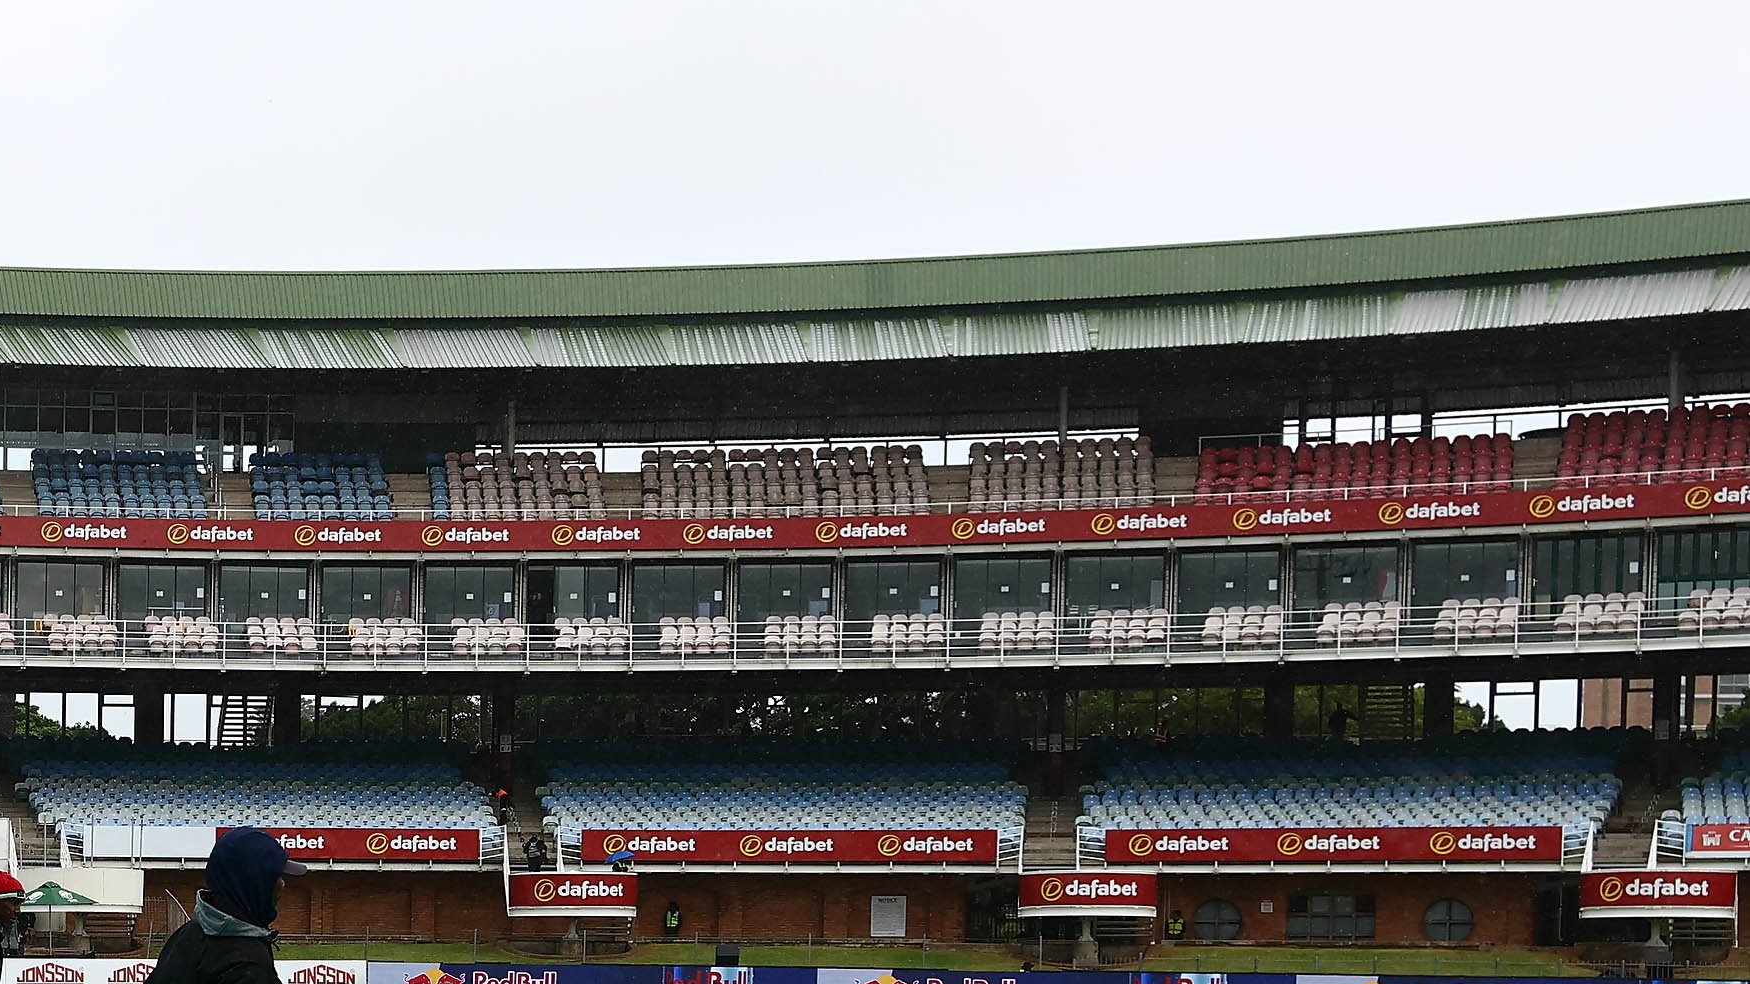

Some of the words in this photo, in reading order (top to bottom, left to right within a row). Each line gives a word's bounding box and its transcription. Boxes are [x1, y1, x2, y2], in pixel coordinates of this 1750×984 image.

[1713, 485, 1750, 504] daf
[1403, 503, 1480, 521] dafabet
[1557, 494, 1634, 513] dafabet
[1117, 514, 1187, 531] dafabet
[1259, 508, 1331, 526] dafabet
[64, 524, 126, 540] dafabet
[190, 526, 253, 542] dafabet
[445, 527, 509, 544] dafabet
[575, 526, 640, 543] dafabet
[707, 525, 773, 541] dafabet
[840, 523, 907, 539] dafabet
[977, 518, 1045, 536] dafabet
[318, 528, 381, 544] dafabet
[276, 834, 324, 850] fabet
[390, 835, 456, 852] dafabet
[628, 837, 695, 853] dafabet
[765, 837, 833, 854] dafabet
[903, 837, 973, 853] dafabet
[1155, 836, 1228, 853] dafabet
[1305, 835, 1379, 852] dafabet
[1458, 834, 1536, 852] dafabet
[558, 881, 623, 899] dafabet
[1065, 880, 1137, 898] dafabet
[1626, 878, 1708, 898] dafabet
[16, 962, 84, 982] JONSSON
[108, 963, 154, 982] JONS
[288, 964, 356, 984] JONSSON
